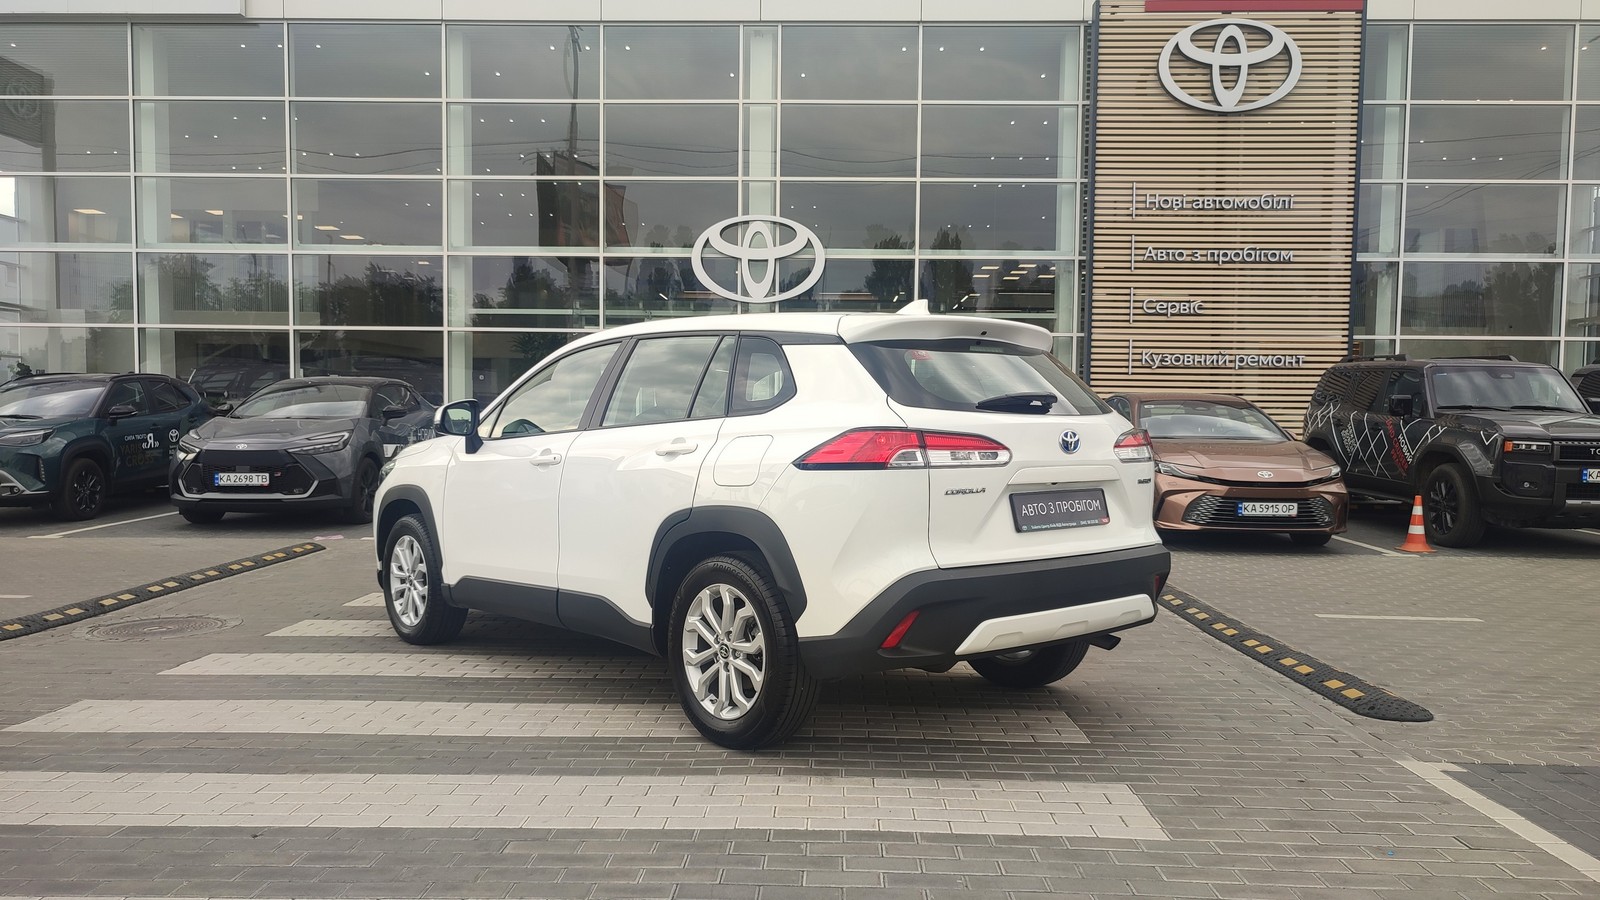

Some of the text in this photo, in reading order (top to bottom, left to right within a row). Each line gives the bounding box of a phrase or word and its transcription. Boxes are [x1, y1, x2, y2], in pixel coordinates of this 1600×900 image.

[1145, 193, 1295, 210] Нові автомобілі
[1143, 246, 1294, 266] Авто з пробігом
[1142, 298, 1205, 318] Сервіс
[1141, 350, 1306, 370] Кузовний ремонт
[1398, 433, 1413, 465] НОВИЙ
[219, 475, 232, 483] KA
[233, 474, 254, 483] 2698
[944, 487, 986, 496] COROLLA
[1021, 502, 1047, 517] АВТО
[1056, 499, 1101, 513] ПРОБІГОМ
[1243, 504, 1257, 513] KA
[1258, 504, 1280, 513] 5915
